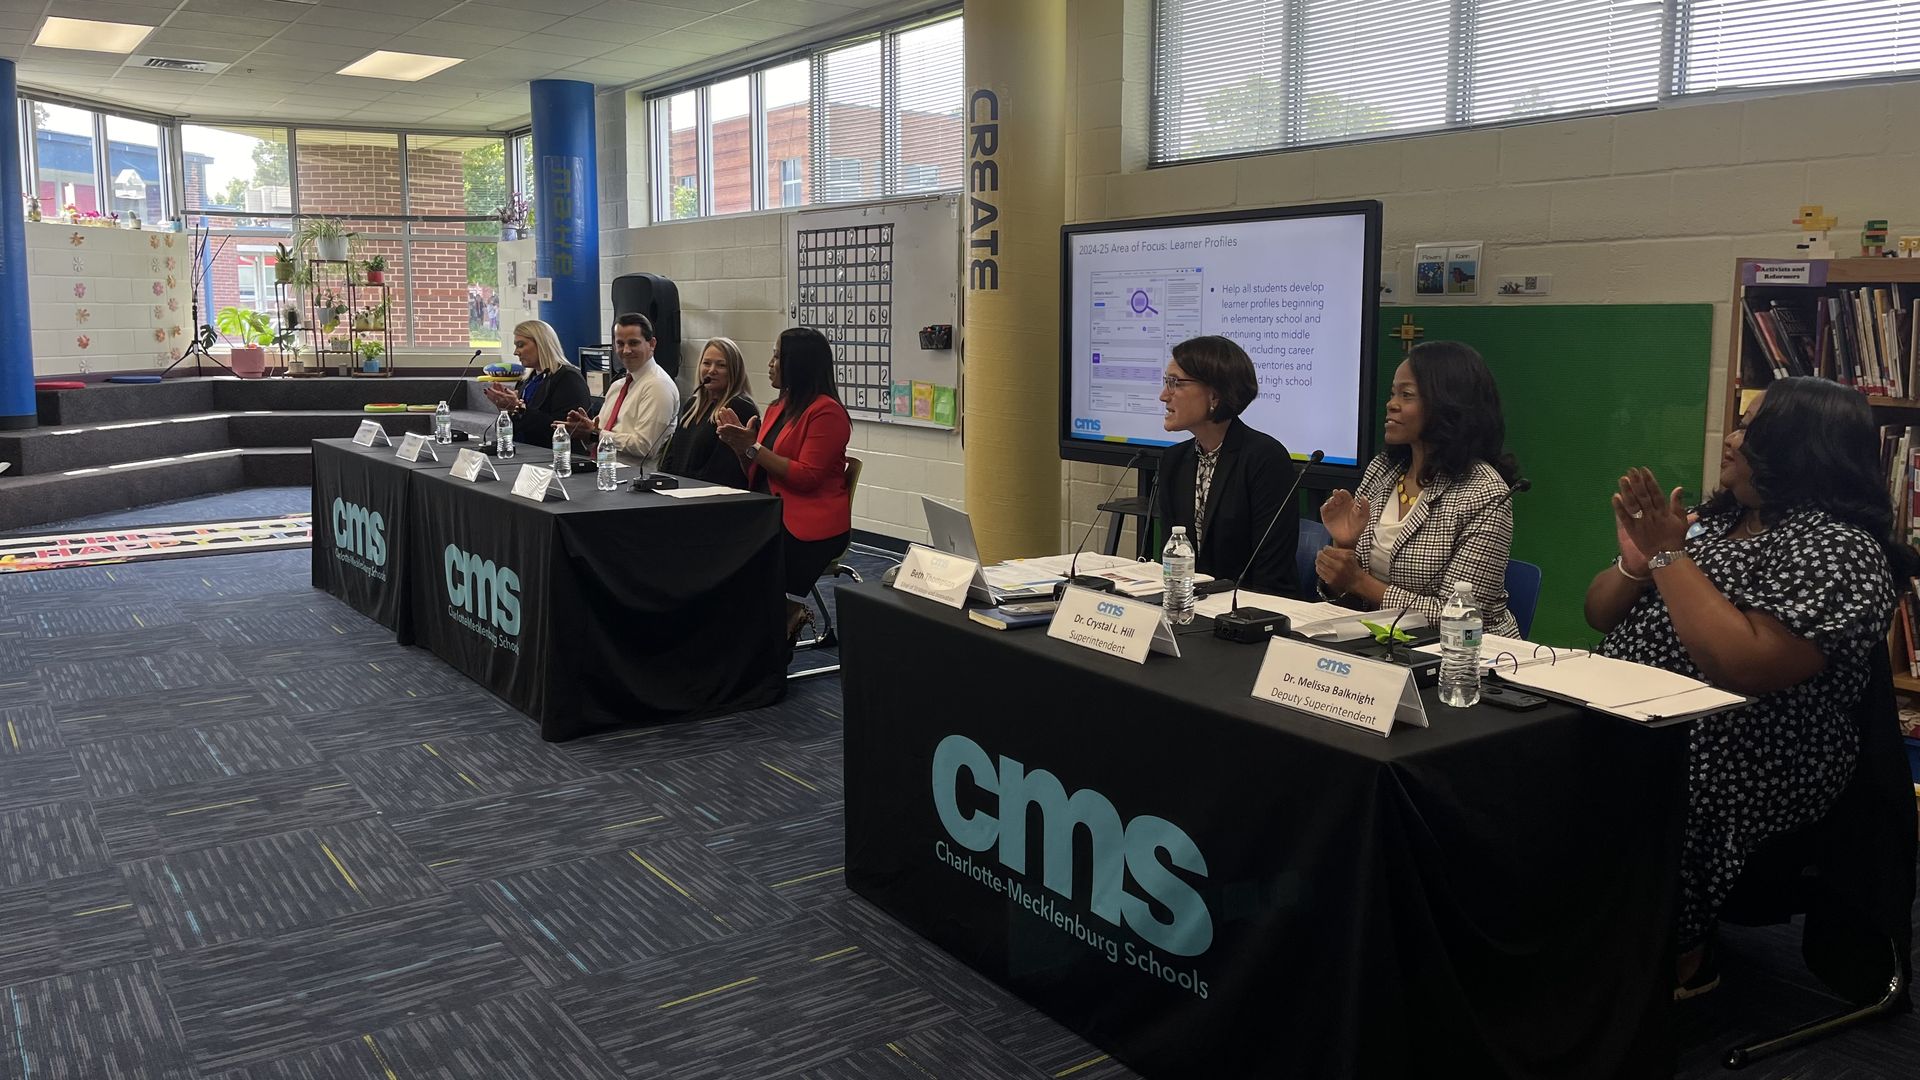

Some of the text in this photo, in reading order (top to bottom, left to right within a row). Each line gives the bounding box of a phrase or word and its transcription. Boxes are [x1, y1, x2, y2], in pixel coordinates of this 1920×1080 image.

[970, 89, 998, 290] CREATE
[1079, 236, 1238, 255] 2024-25 Area of Focus: Learner Profiles
[870, 247, 877, 261] 2
[1222, 282, 1325, 295] Help all students develop
[1221, 298, 1325, 310] learner profiles beginning
[801, 309, 807, 322] 5
[809, 309, 815, 322] 7
[847, 310, 853, 323] 2
[869, 309, 876, 323] 6
[881, 309, 888, 323] 9
[1221, 313, 1321, 326] in elementary school and
[837, 326, 843, 340] 3
[881, 330, 887, 343] 7
[1221, 329, 1311, 341] continuing into middle
[838, 348, 844, 360] 2
[1249, 344, 1286, 357] including
[1288, 346, 1315, 355] career
[1252, 361, 1313, 371] nventories and
[838, 368, 844, 382] 5
[881, 369, 888, 383] 2
[1265, 375, 1283, 388] high
[1285, 376, 1313, 387] school
[858, 391, 889, 405] 5 8
[1257, 391, 1281, 403] nning
[1074, 417, 1101, 431] cms
[333, 497, 387, 566] cms
[910, 569, 925, 580] Beth
[445, 543, 521, 636] cms
[1097, 601, 1124, 617] cms
[1074, 614, 1136, 638] Dr. Crystal L. Hill
[1069, 630, 1126, 654] Superintendent
[1317, 657, 1352, 676] cms
[1283, 673, 1376, 706] Dr. Melissa Balknight
[1270, 687, 1377, 726] Deputy Superintendent
[932, 735, 1213, 957] cms
[935, 840, 1209, 1000] Charlotte-Mecklenburg Schools
